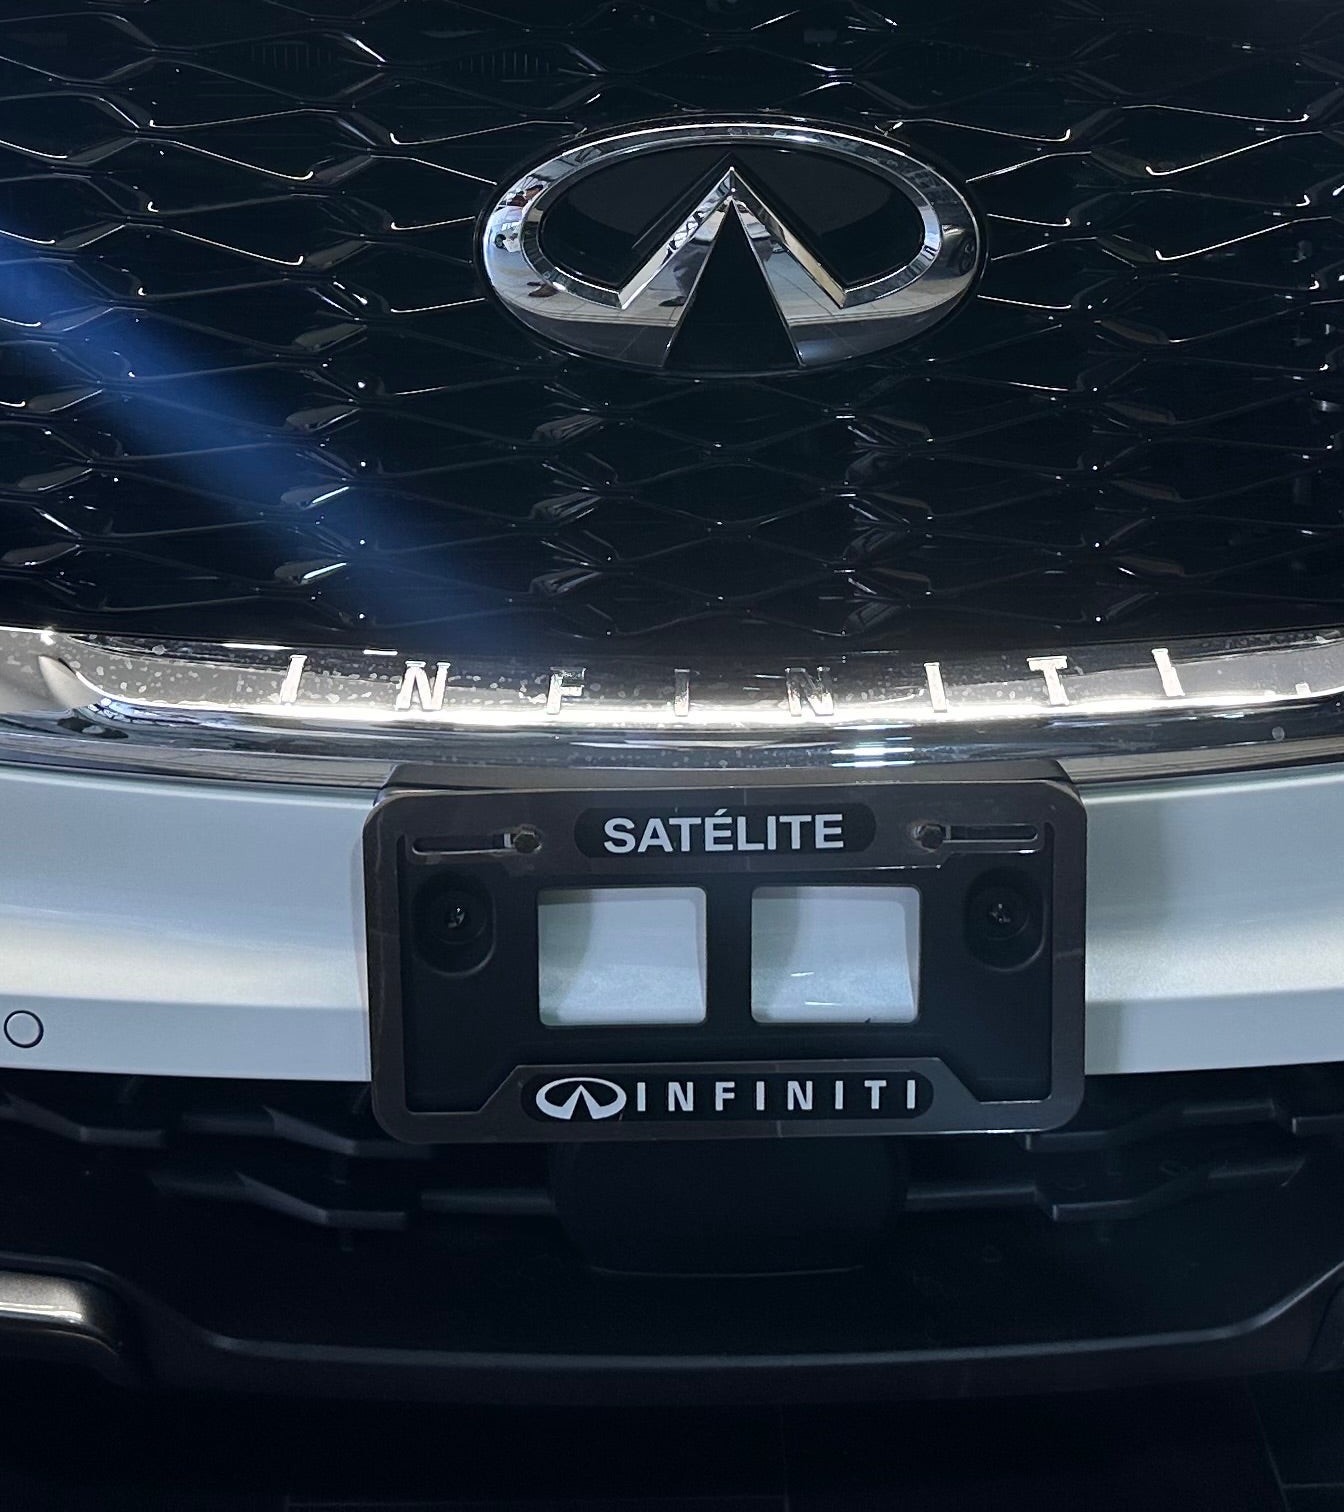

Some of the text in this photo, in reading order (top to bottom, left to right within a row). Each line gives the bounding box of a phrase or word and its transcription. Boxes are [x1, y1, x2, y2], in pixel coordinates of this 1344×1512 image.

[278, 647, 1186, 717] INFINITI
[602, 808, 845, 855] SATÉLITE
[636, 1079, 918, 1114] INFINITI
